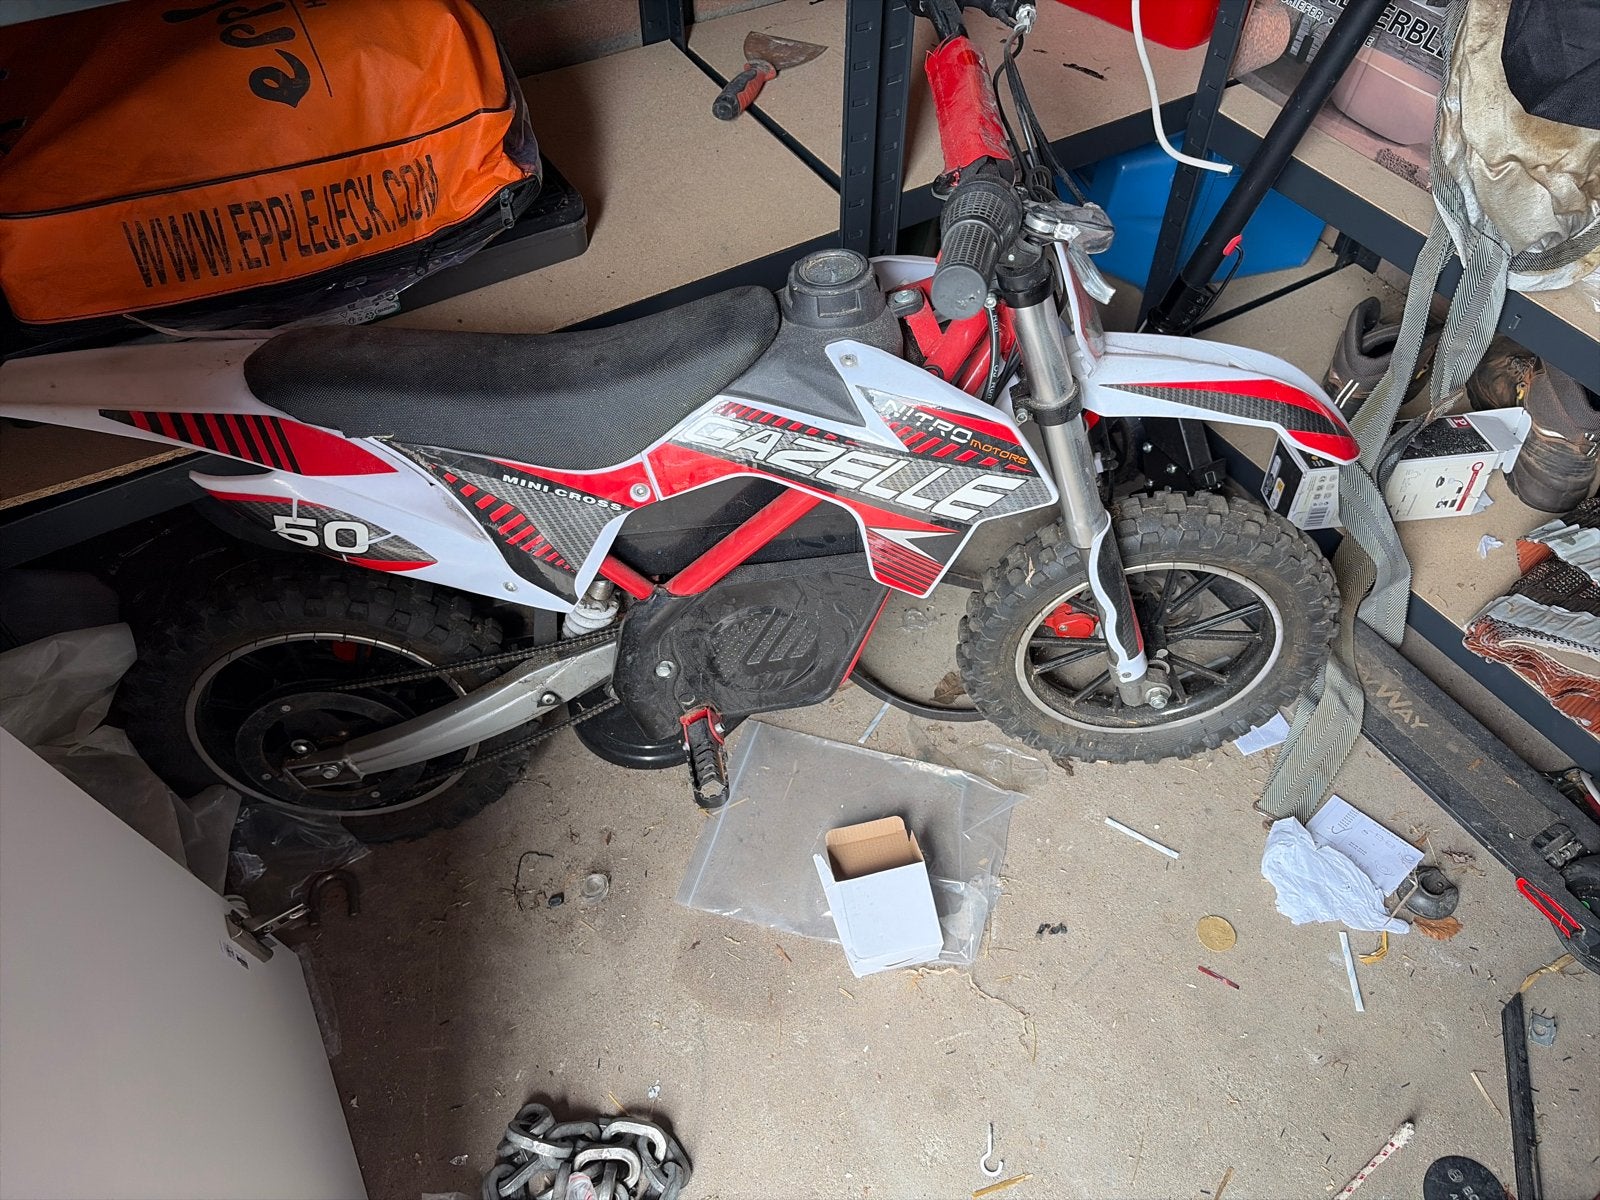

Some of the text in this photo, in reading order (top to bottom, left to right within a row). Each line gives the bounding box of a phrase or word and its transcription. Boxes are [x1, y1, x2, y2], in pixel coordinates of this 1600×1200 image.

[122, 154, 439, 288] WWW.EPPLEJECK.COM
[881, 399, 1029, 465] NITRO MOTORS
[502, 474, 622, 511] MINI CROSS
[684, 416, 1028, 521] GAZELLE
[273, 514, 370, 554] 50
